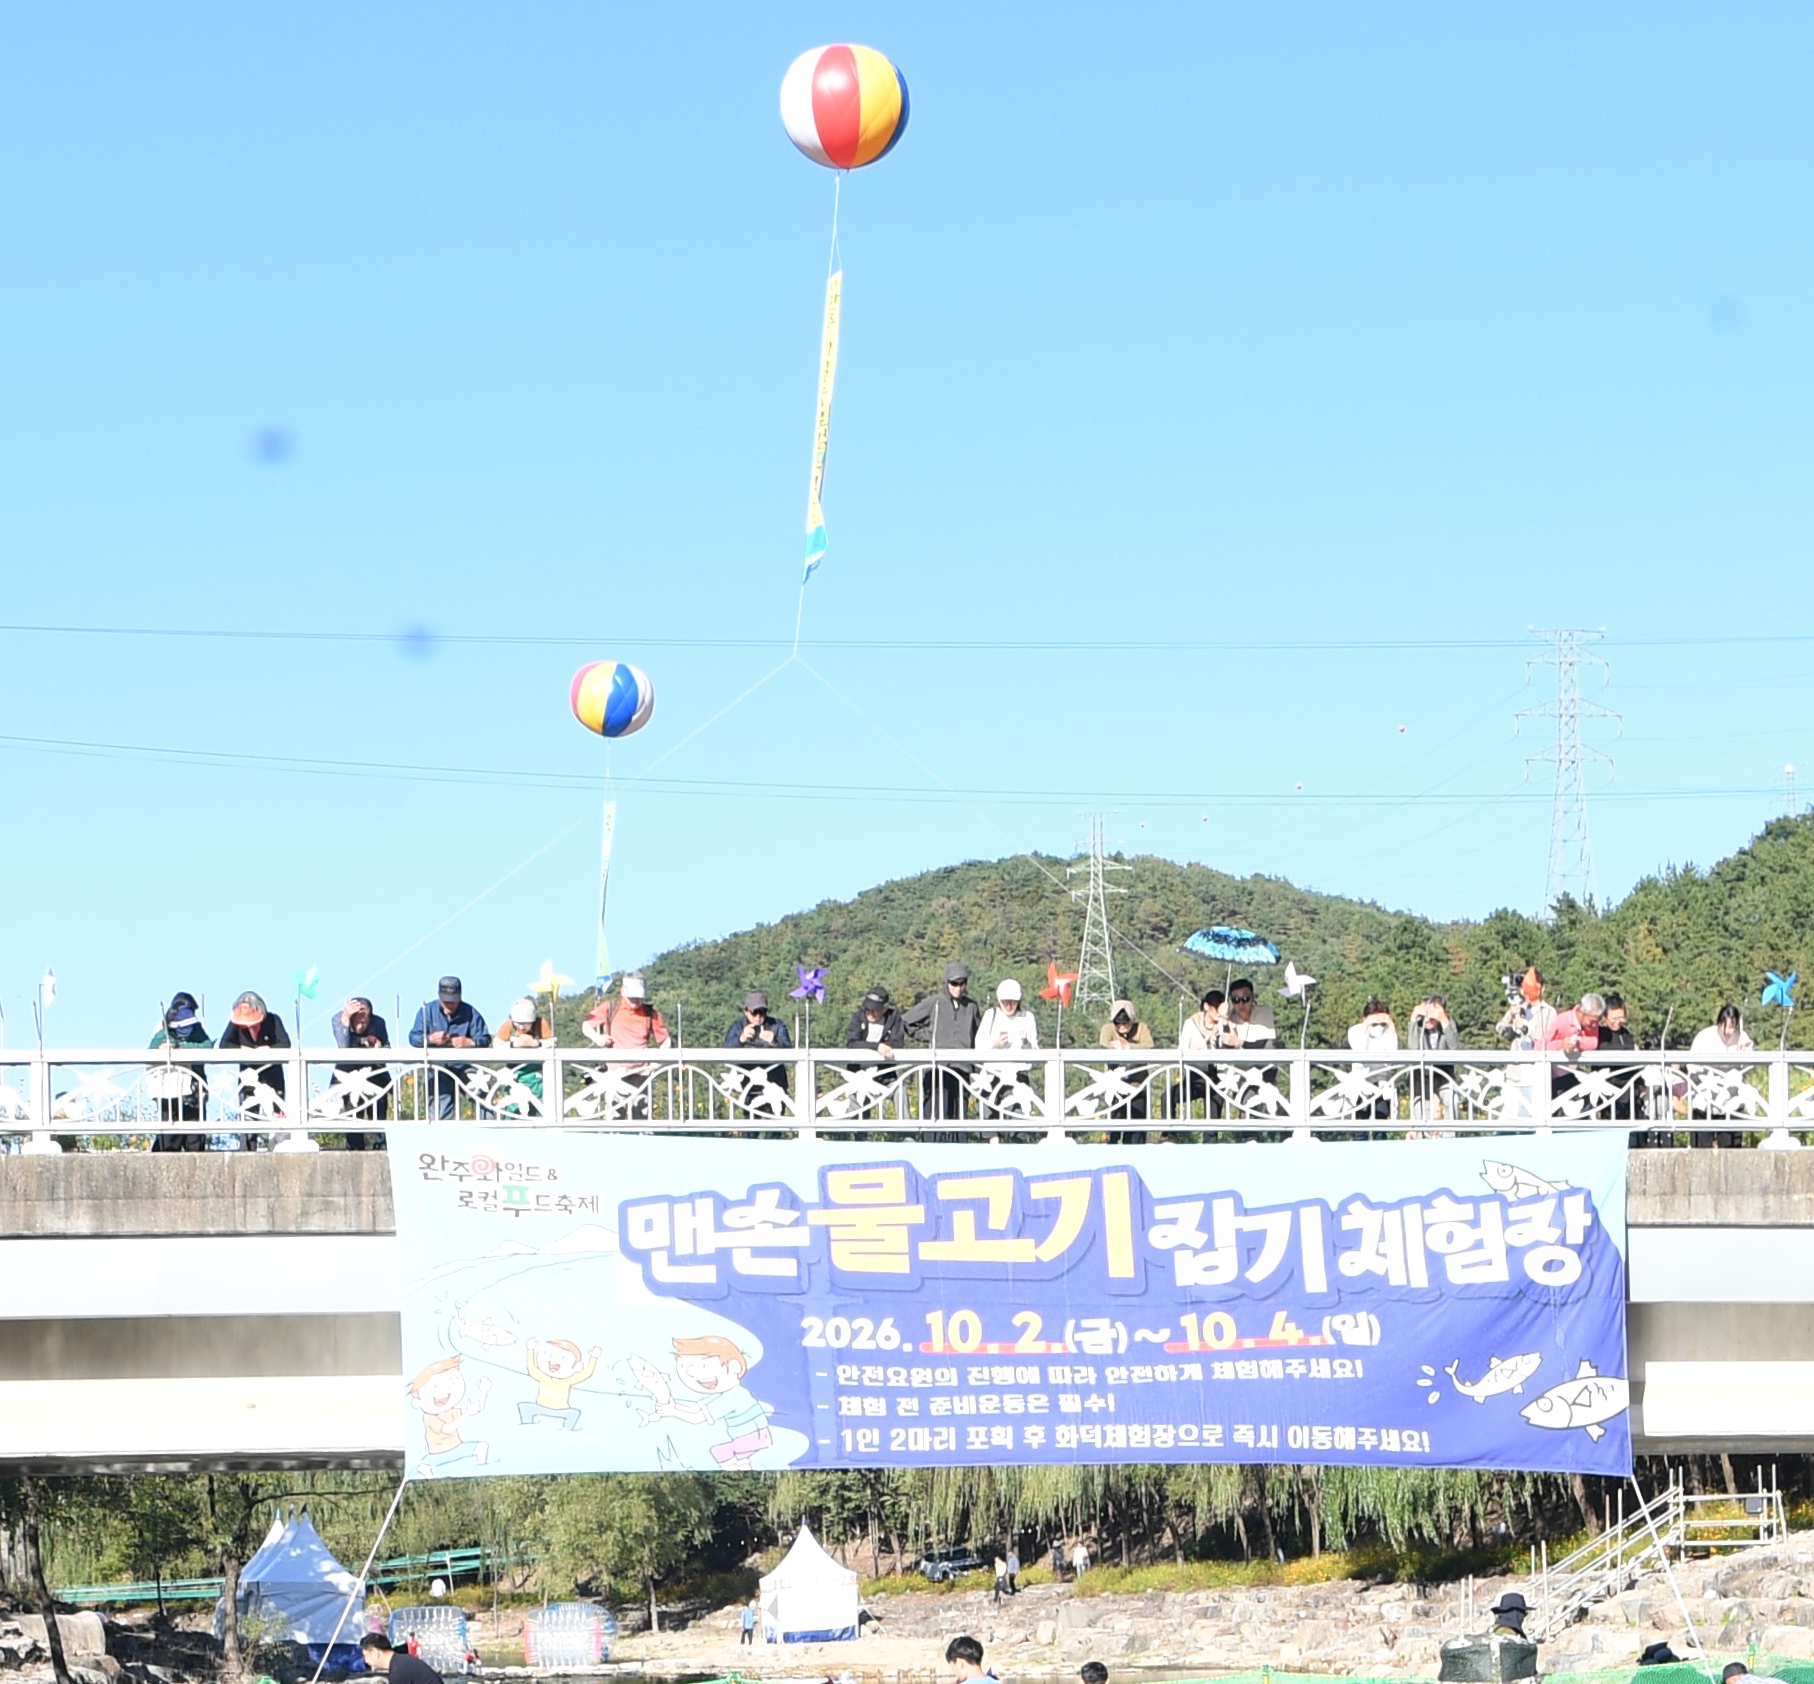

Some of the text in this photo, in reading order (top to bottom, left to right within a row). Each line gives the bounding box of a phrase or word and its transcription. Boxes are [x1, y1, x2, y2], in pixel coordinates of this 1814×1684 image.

[627, 1166, 1592, 1293] 맨손 물고기 잡기 체험장
[801, 1317, 913, 1352] 2026.
[836, 1364, 959, 1388] 안전요원의
[967, 1365, 1040, 1386] 진행에
[1048, 1365, 1097, 1385] 따라
[1105, 1362, 1203, 1385] 안전하게
[1211, 1358, 1364, 1380] 체험해주세요!
[838, 1395, 887, 1417] 체험
[896, 1396, 920, 1417] 전
[929, 1393, 1050, 1416] 준비운동은
[1058, 1392, 1115, 1413] 필수!
[841, 1427, 880, 1452] 1인
[890, 1426, 956, 1452] 2마리
[966, 1425, 1014, 1450] 포획
[1023, 1425, 1047, 1449] 후
[1055, 1423, 1225, 1449] 화덕체험장으로
[1232, 1424, 1279, 1449] 즉시
[1287, 1425, 1431, 1453] 이동해주세요!
